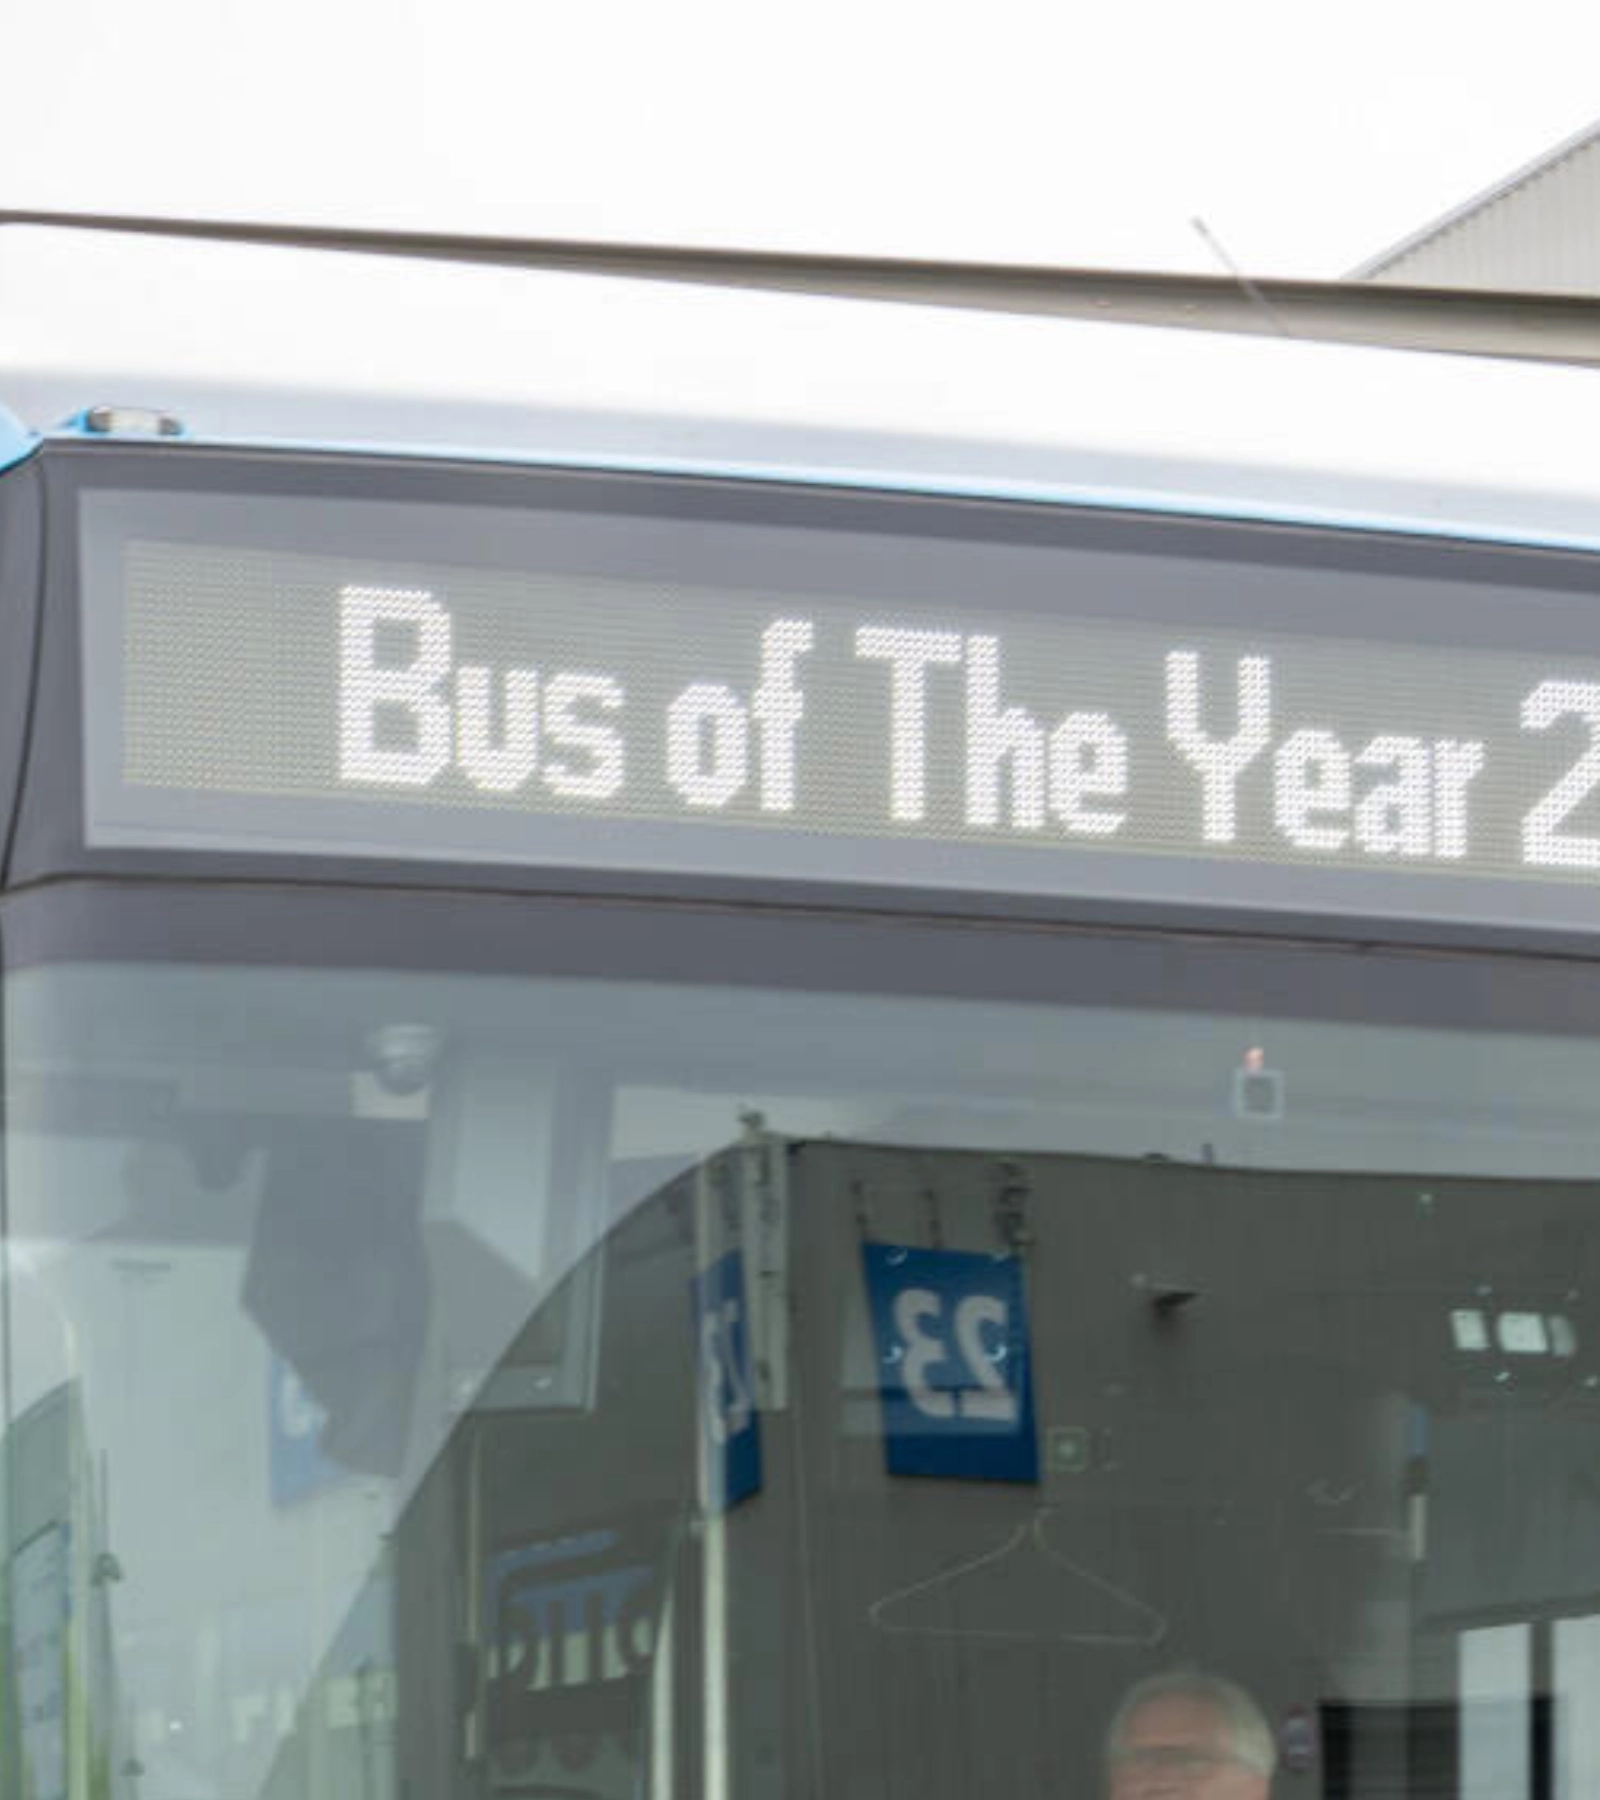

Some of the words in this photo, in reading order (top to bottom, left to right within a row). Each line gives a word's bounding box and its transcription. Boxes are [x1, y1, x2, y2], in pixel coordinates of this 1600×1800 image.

[339, 585, 625, 801] Bus
[666, 619, 813, 811] of
[856, 625, 1128, 834] The
[1164, 650, 1486, 859] Year
